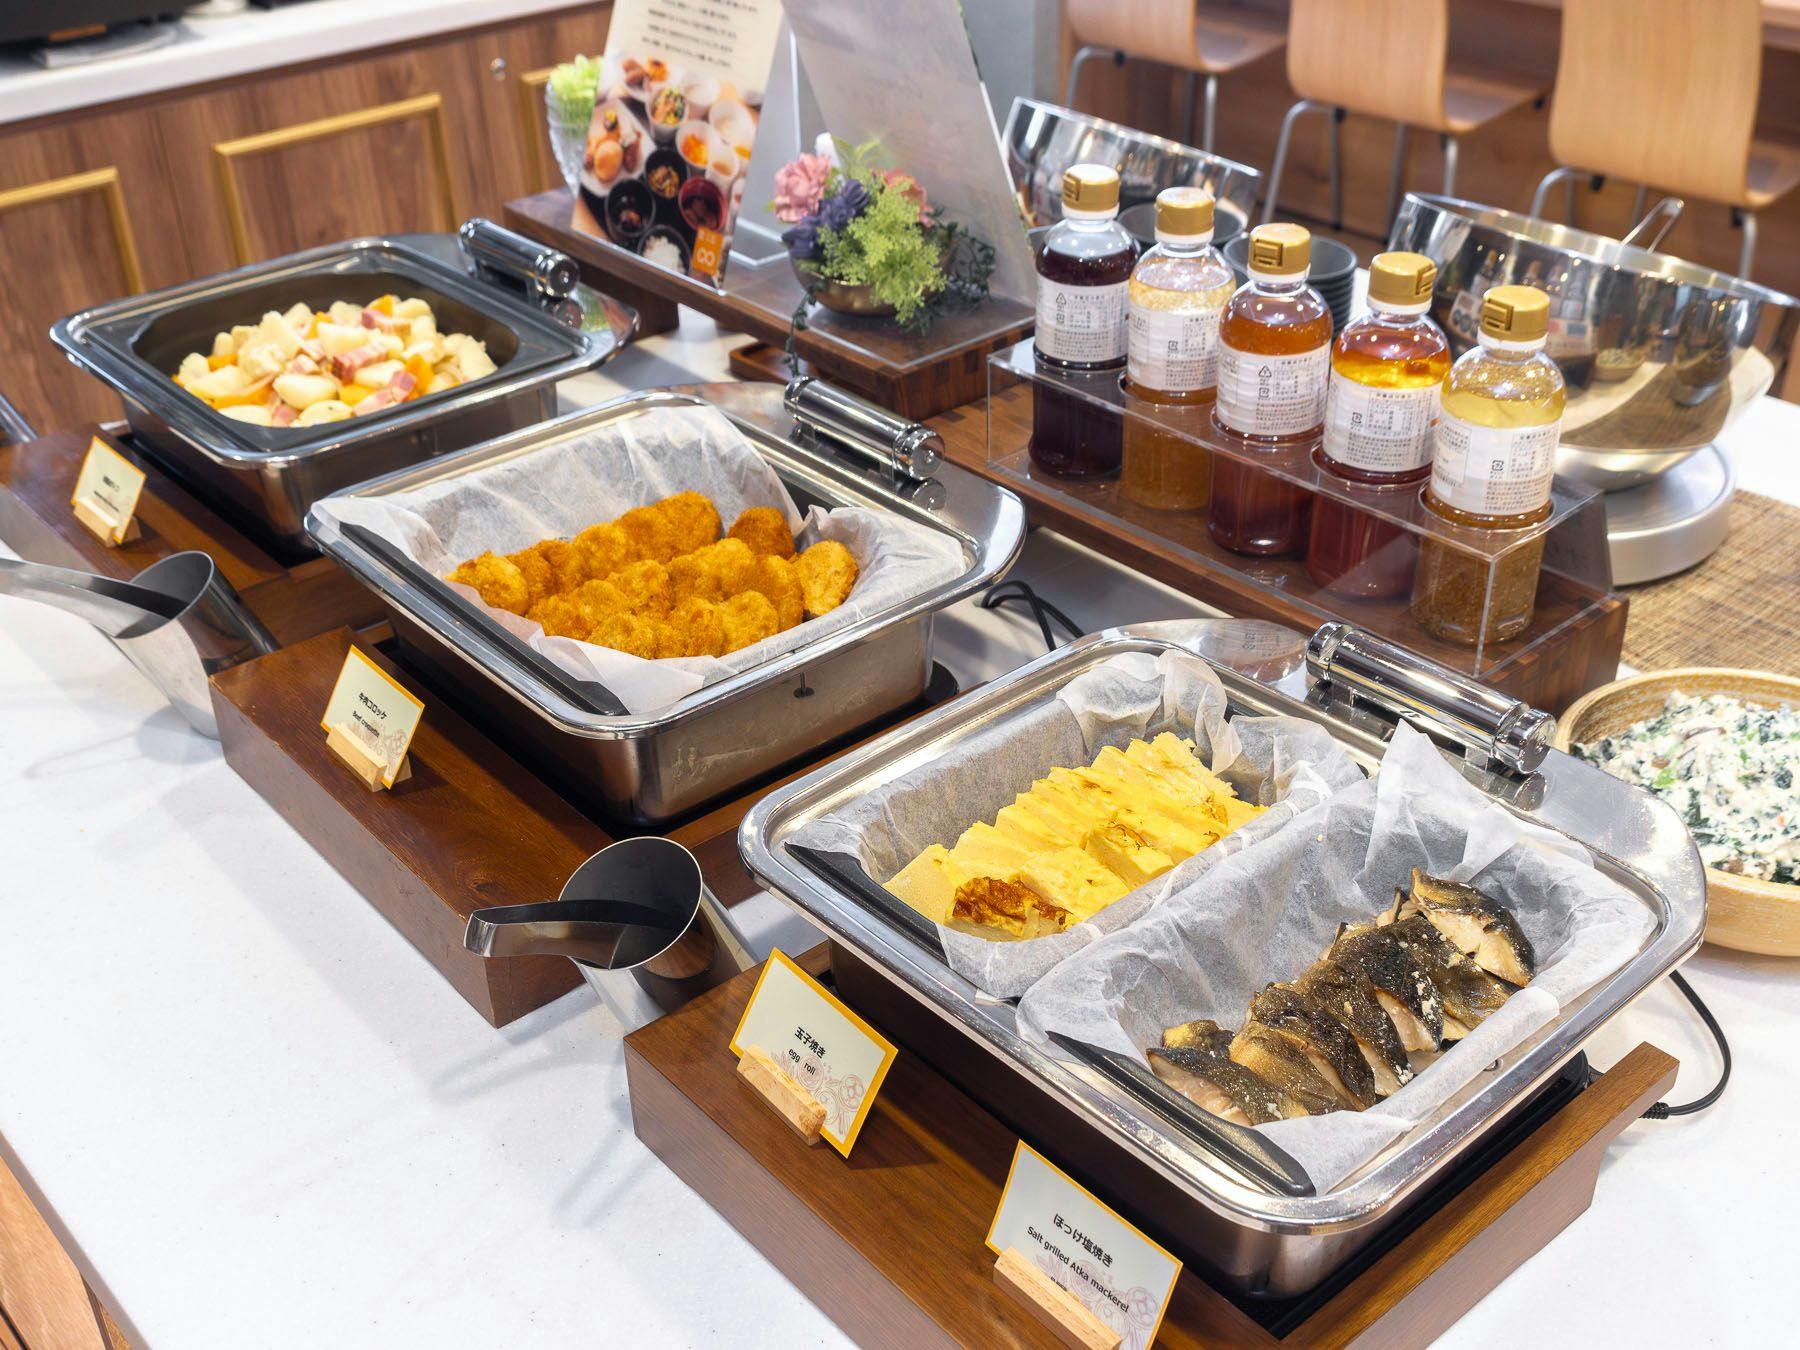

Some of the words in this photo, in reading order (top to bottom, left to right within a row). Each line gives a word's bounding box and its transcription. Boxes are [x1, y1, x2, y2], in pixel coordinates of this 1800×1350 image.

[788, 1048, 801, 1063] egg
[803, 1062, 816, 1076] roll
[794, 1026, 826, 1059] 玉子焼き
[1053, 1213, 1113, 1268] ほっけ塩焼き
[1027, 1226, 1044, 1244] Salt
[1043, 1240, 1070, 1266] grilled
[1069, 1262, 1089, 1282] Atka
[1090, 1278, 1129, 1313] mackerel
